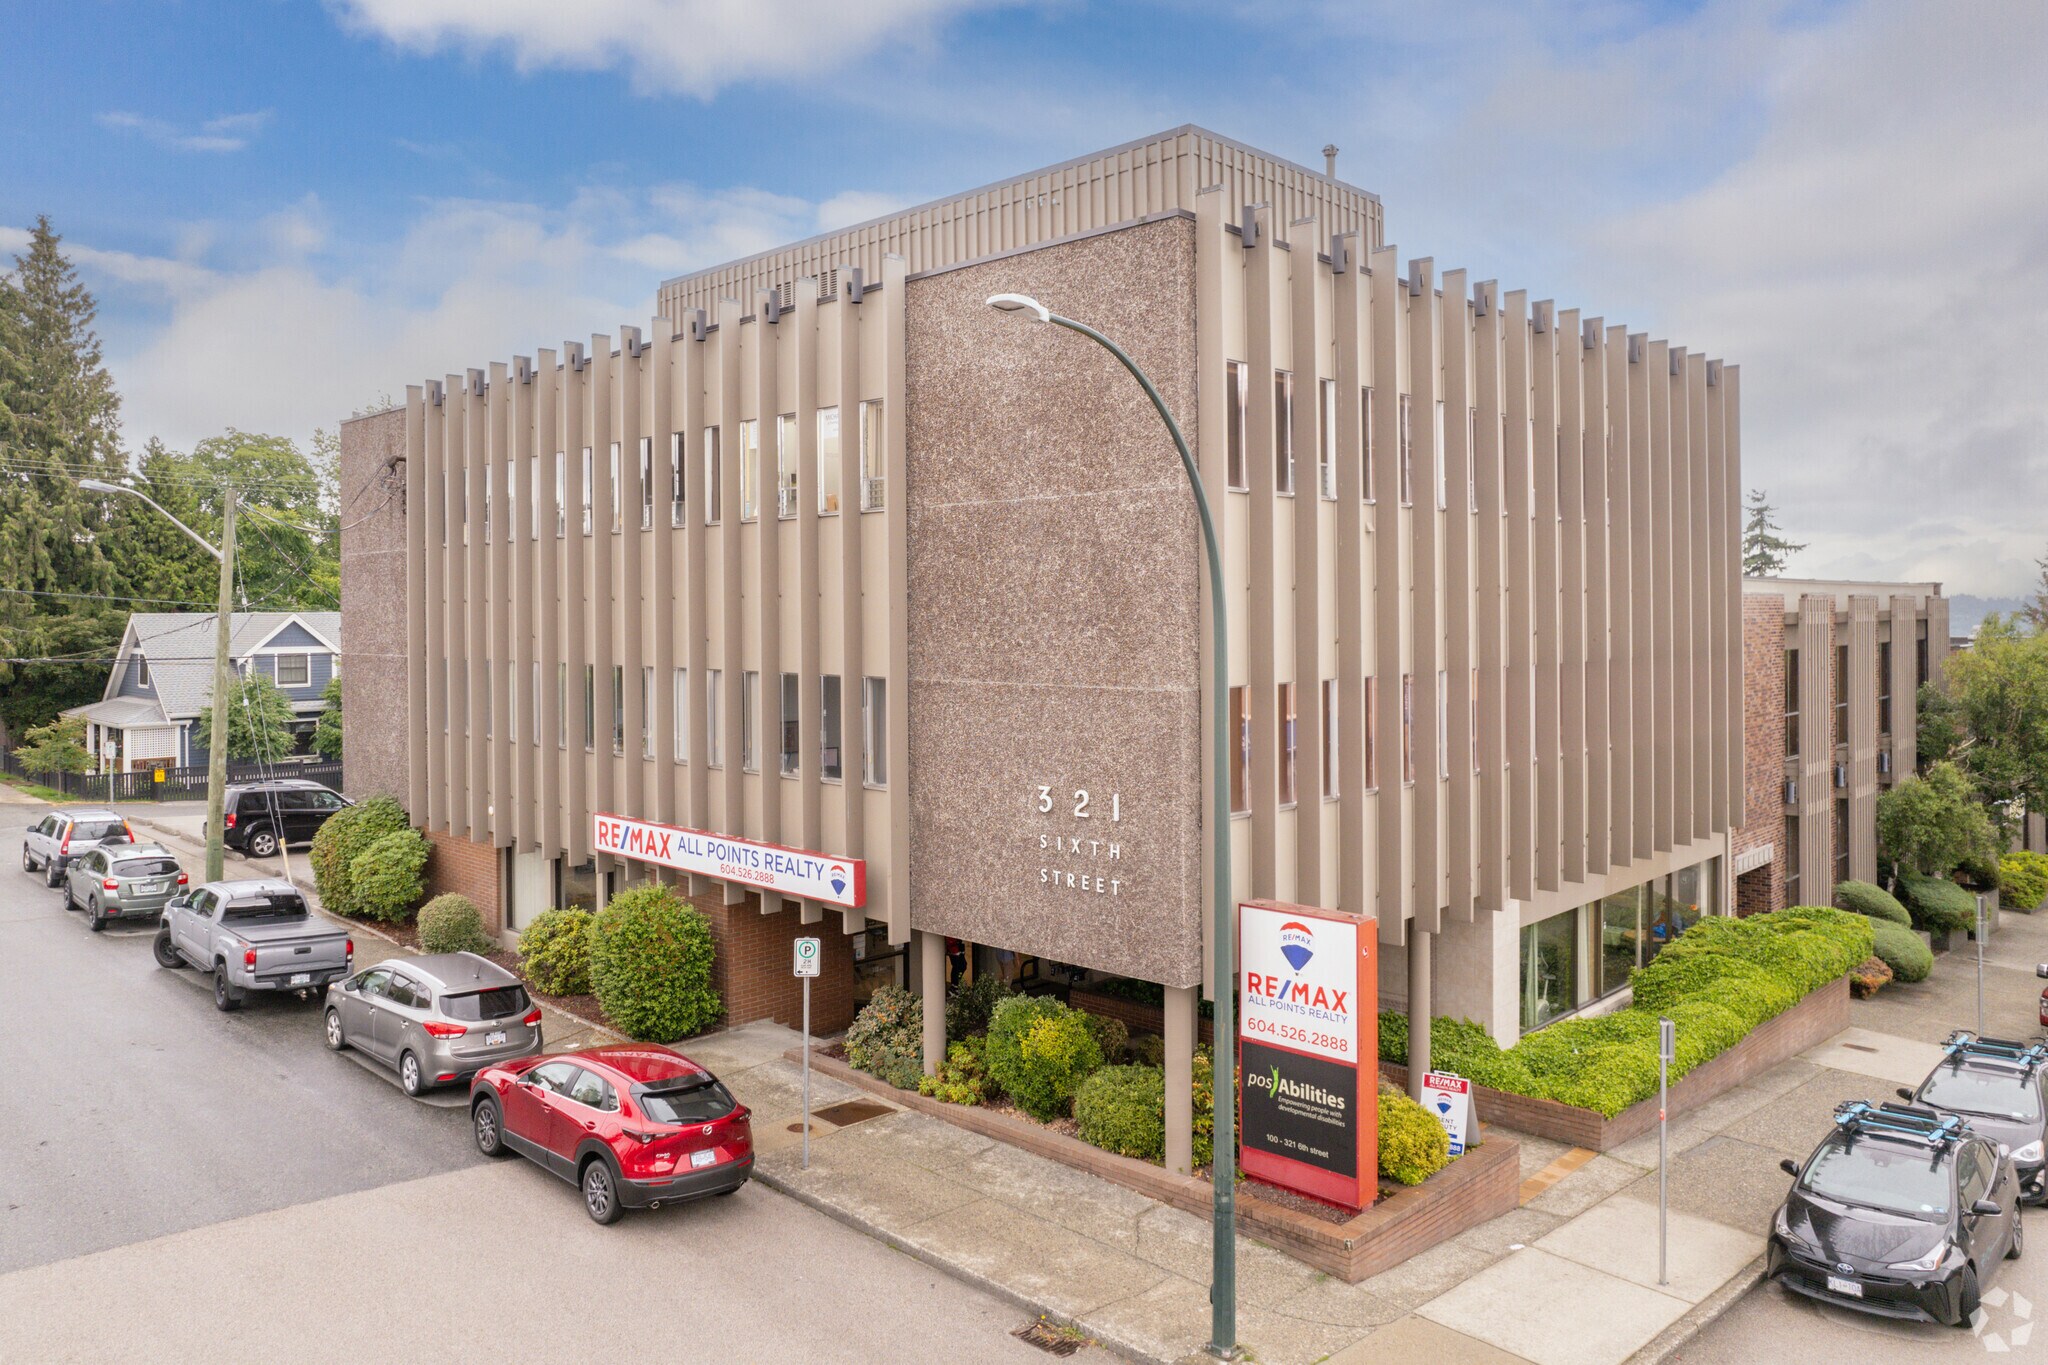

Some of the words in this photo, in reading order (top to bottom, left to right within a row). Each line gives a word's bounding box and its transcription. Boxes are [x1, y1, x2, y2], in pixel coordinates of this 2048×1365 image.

[1038, 785, 1120, 821] 321
[598, 821, 671, 859] RE/MAX
[678, 835, 703, 856] ALL
[707, 841, 759, 868] POINTS
[765, 853, 825, 881] REALTY
[1040, 834, 1120, 860] SIXTH
[720, 863, 775, 884] 604.526.2888
[1040, 868, 1120, 896] STREET
[1283, 934, 1311, 946] RE/MAX
[1248, 971, 1348, 1014] RE/MAX
[1248, 995, 1266, 1007] ALL
[1269, 999, 1306, 1015] POINTS
[1308, 1008, 1348, 1025] REALTY
[1247, 1017, 1348, 1052] 604.526.2888
[1429, 1076, 1462, 1089] RE/MAX
[1278, 1096, 1311, 1111] Empowering
[1311, 1105, 1329, 1116] people
[1329, 1110, 1342, 1118] with
[1278, 1104, 1317, 1120] developmental
[1317, 1113, 1346, 1128] disabilities
[1266, 1134, 1278, 1144] 100
[1284, 1138, 1296, 1148] 321
[1297, 1142, 1309, 1152] 6th
[1310, 1147, 1329, 1158] street
